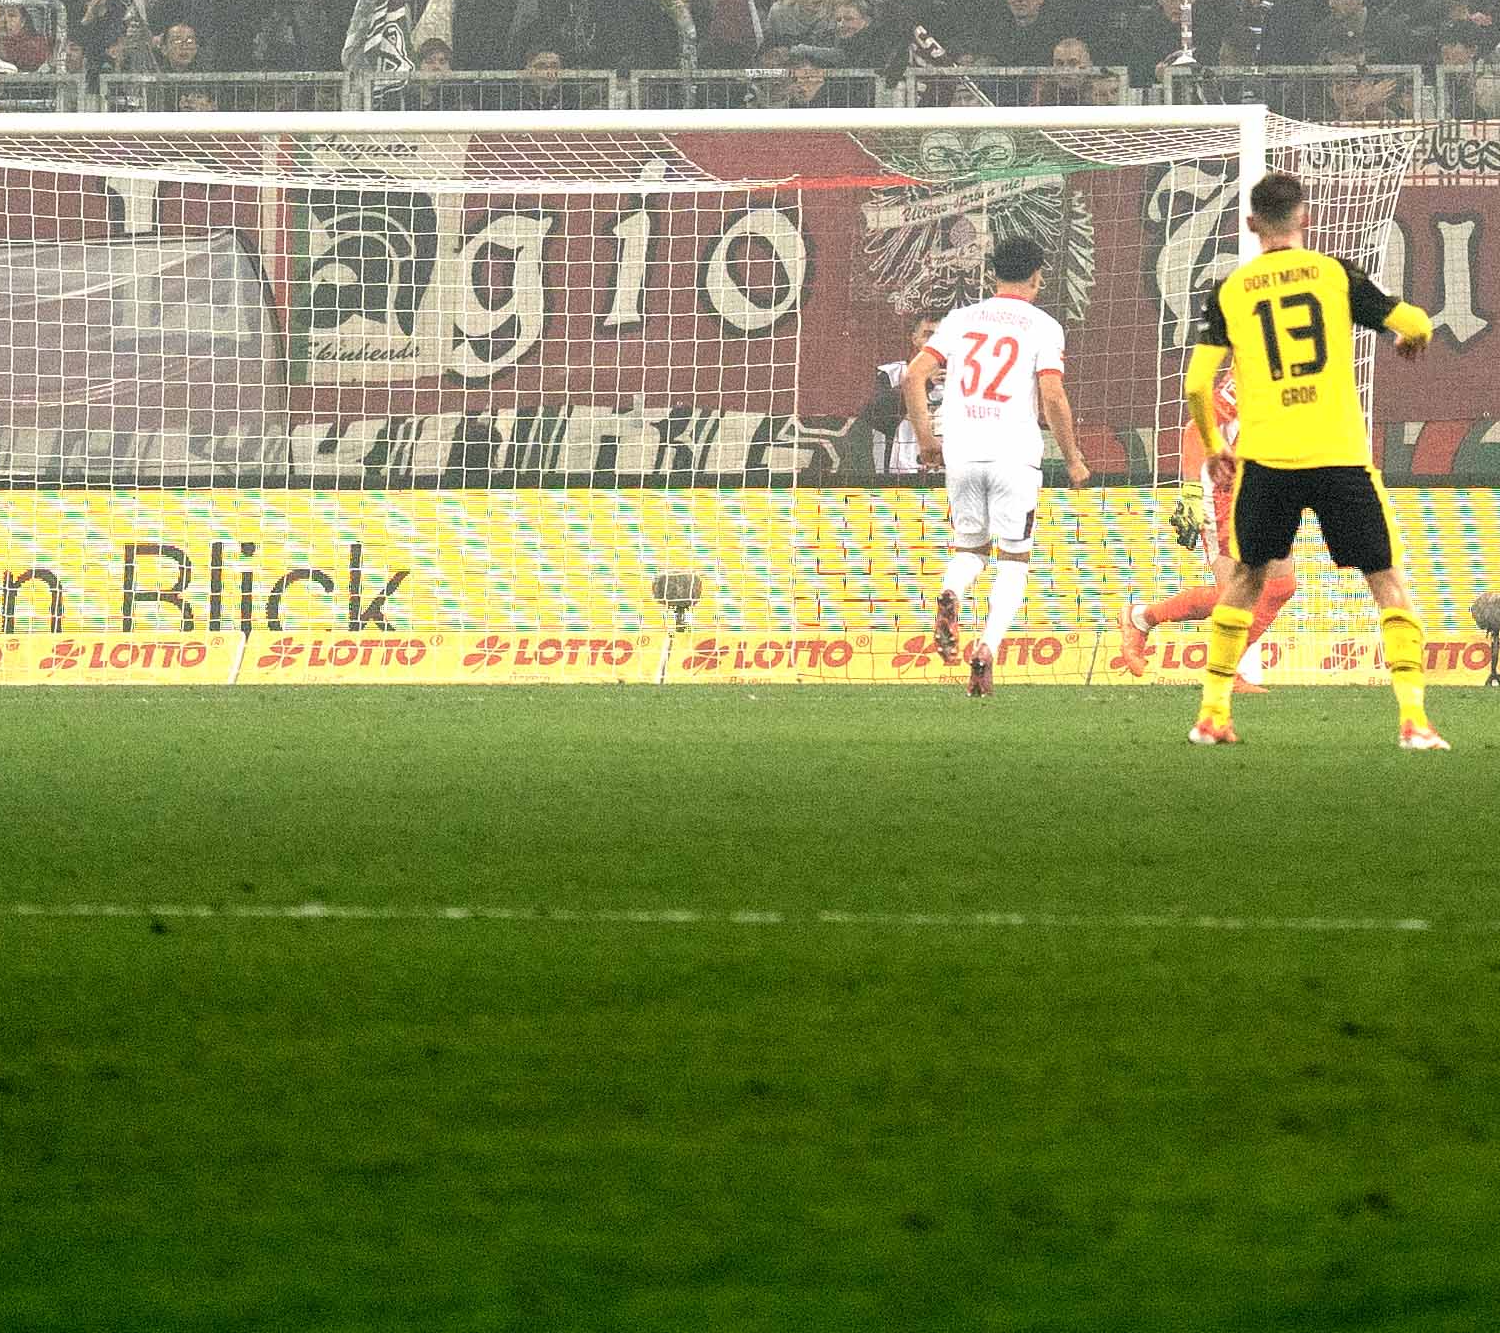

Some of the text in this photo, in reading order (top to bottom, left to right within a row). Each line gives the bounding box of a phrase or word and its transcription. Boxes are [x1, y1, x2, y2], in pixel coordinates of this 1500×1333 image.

[1243, 266, 1320, 293] DORTMUND
[1252, 291, 1328, 382] 13
[960, 331, 1020, 403] 32
[121, 539, 412, 633] Blick
[88, 641, 207, 668] LOTTO
[308, 638, 427, 666] LOTTO
[514, 638, 634, 666] LOTTO
[733, 639, 854, 668] LOTTO
